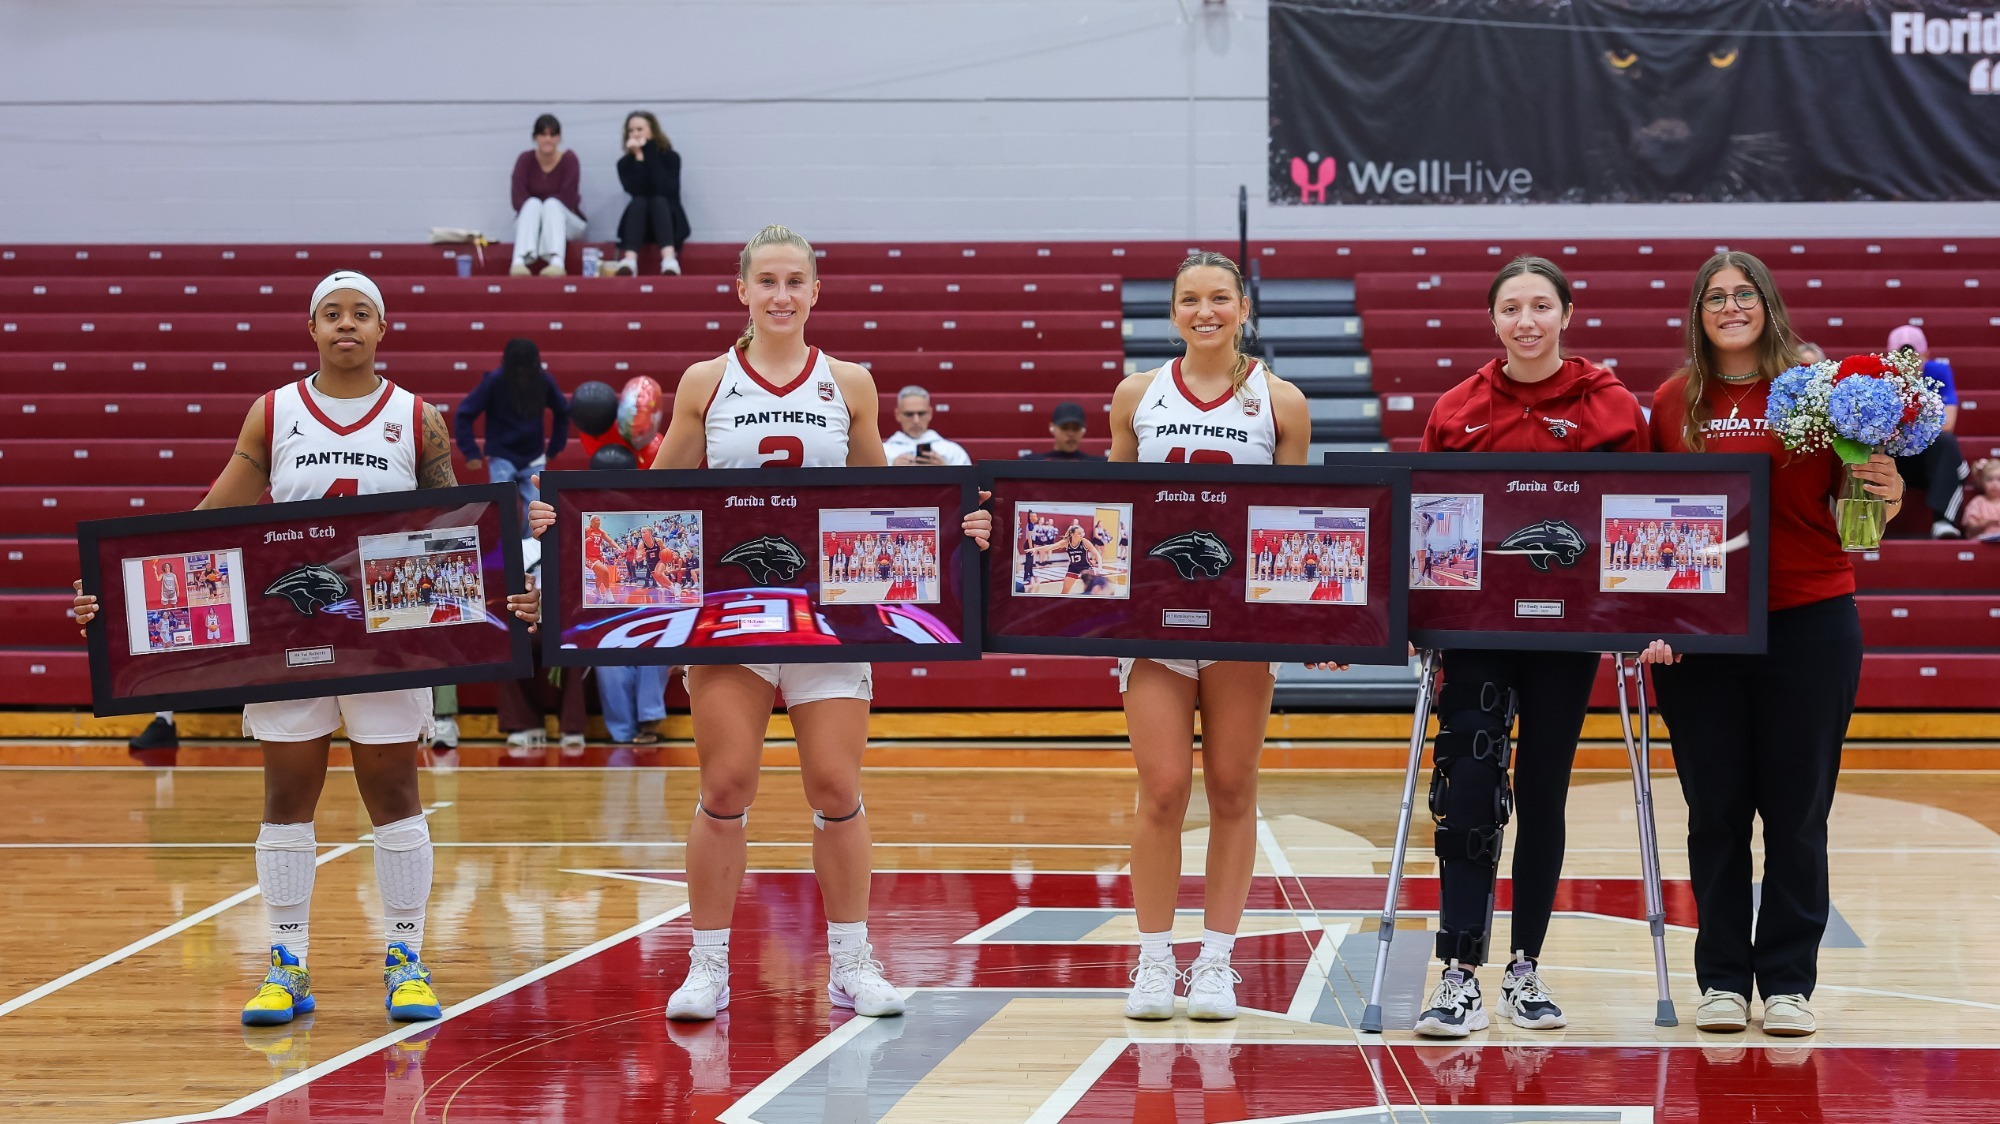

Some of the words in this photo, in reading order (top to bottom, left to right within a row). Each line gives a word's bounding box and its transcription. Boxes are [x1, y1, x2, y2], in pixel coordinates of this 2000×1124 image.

[1347, 160, 1533, 194] WellHive
[734, 411, 827, 428] PANTHERS
[1156, 423, 1248, 443] PANTHERS
[1706, 430, 1766, 439] BASKETBALL
[295, 451, 389, 471] PANTHERS
[1505, 480, 1547, 493] Florida
[1553, 480, 1580, 494] Tech
[724, 495, 765, 508] Florida
[770, 495, 797, 508] Tech
[1154, 490, 1195, 503] Florida
[1200, 490, 1227, 504] Tech
[263, 529, 304, 544] Florida
[308, 525, 336, 539] Tech
[1070, 555, 1082, 563] 13
